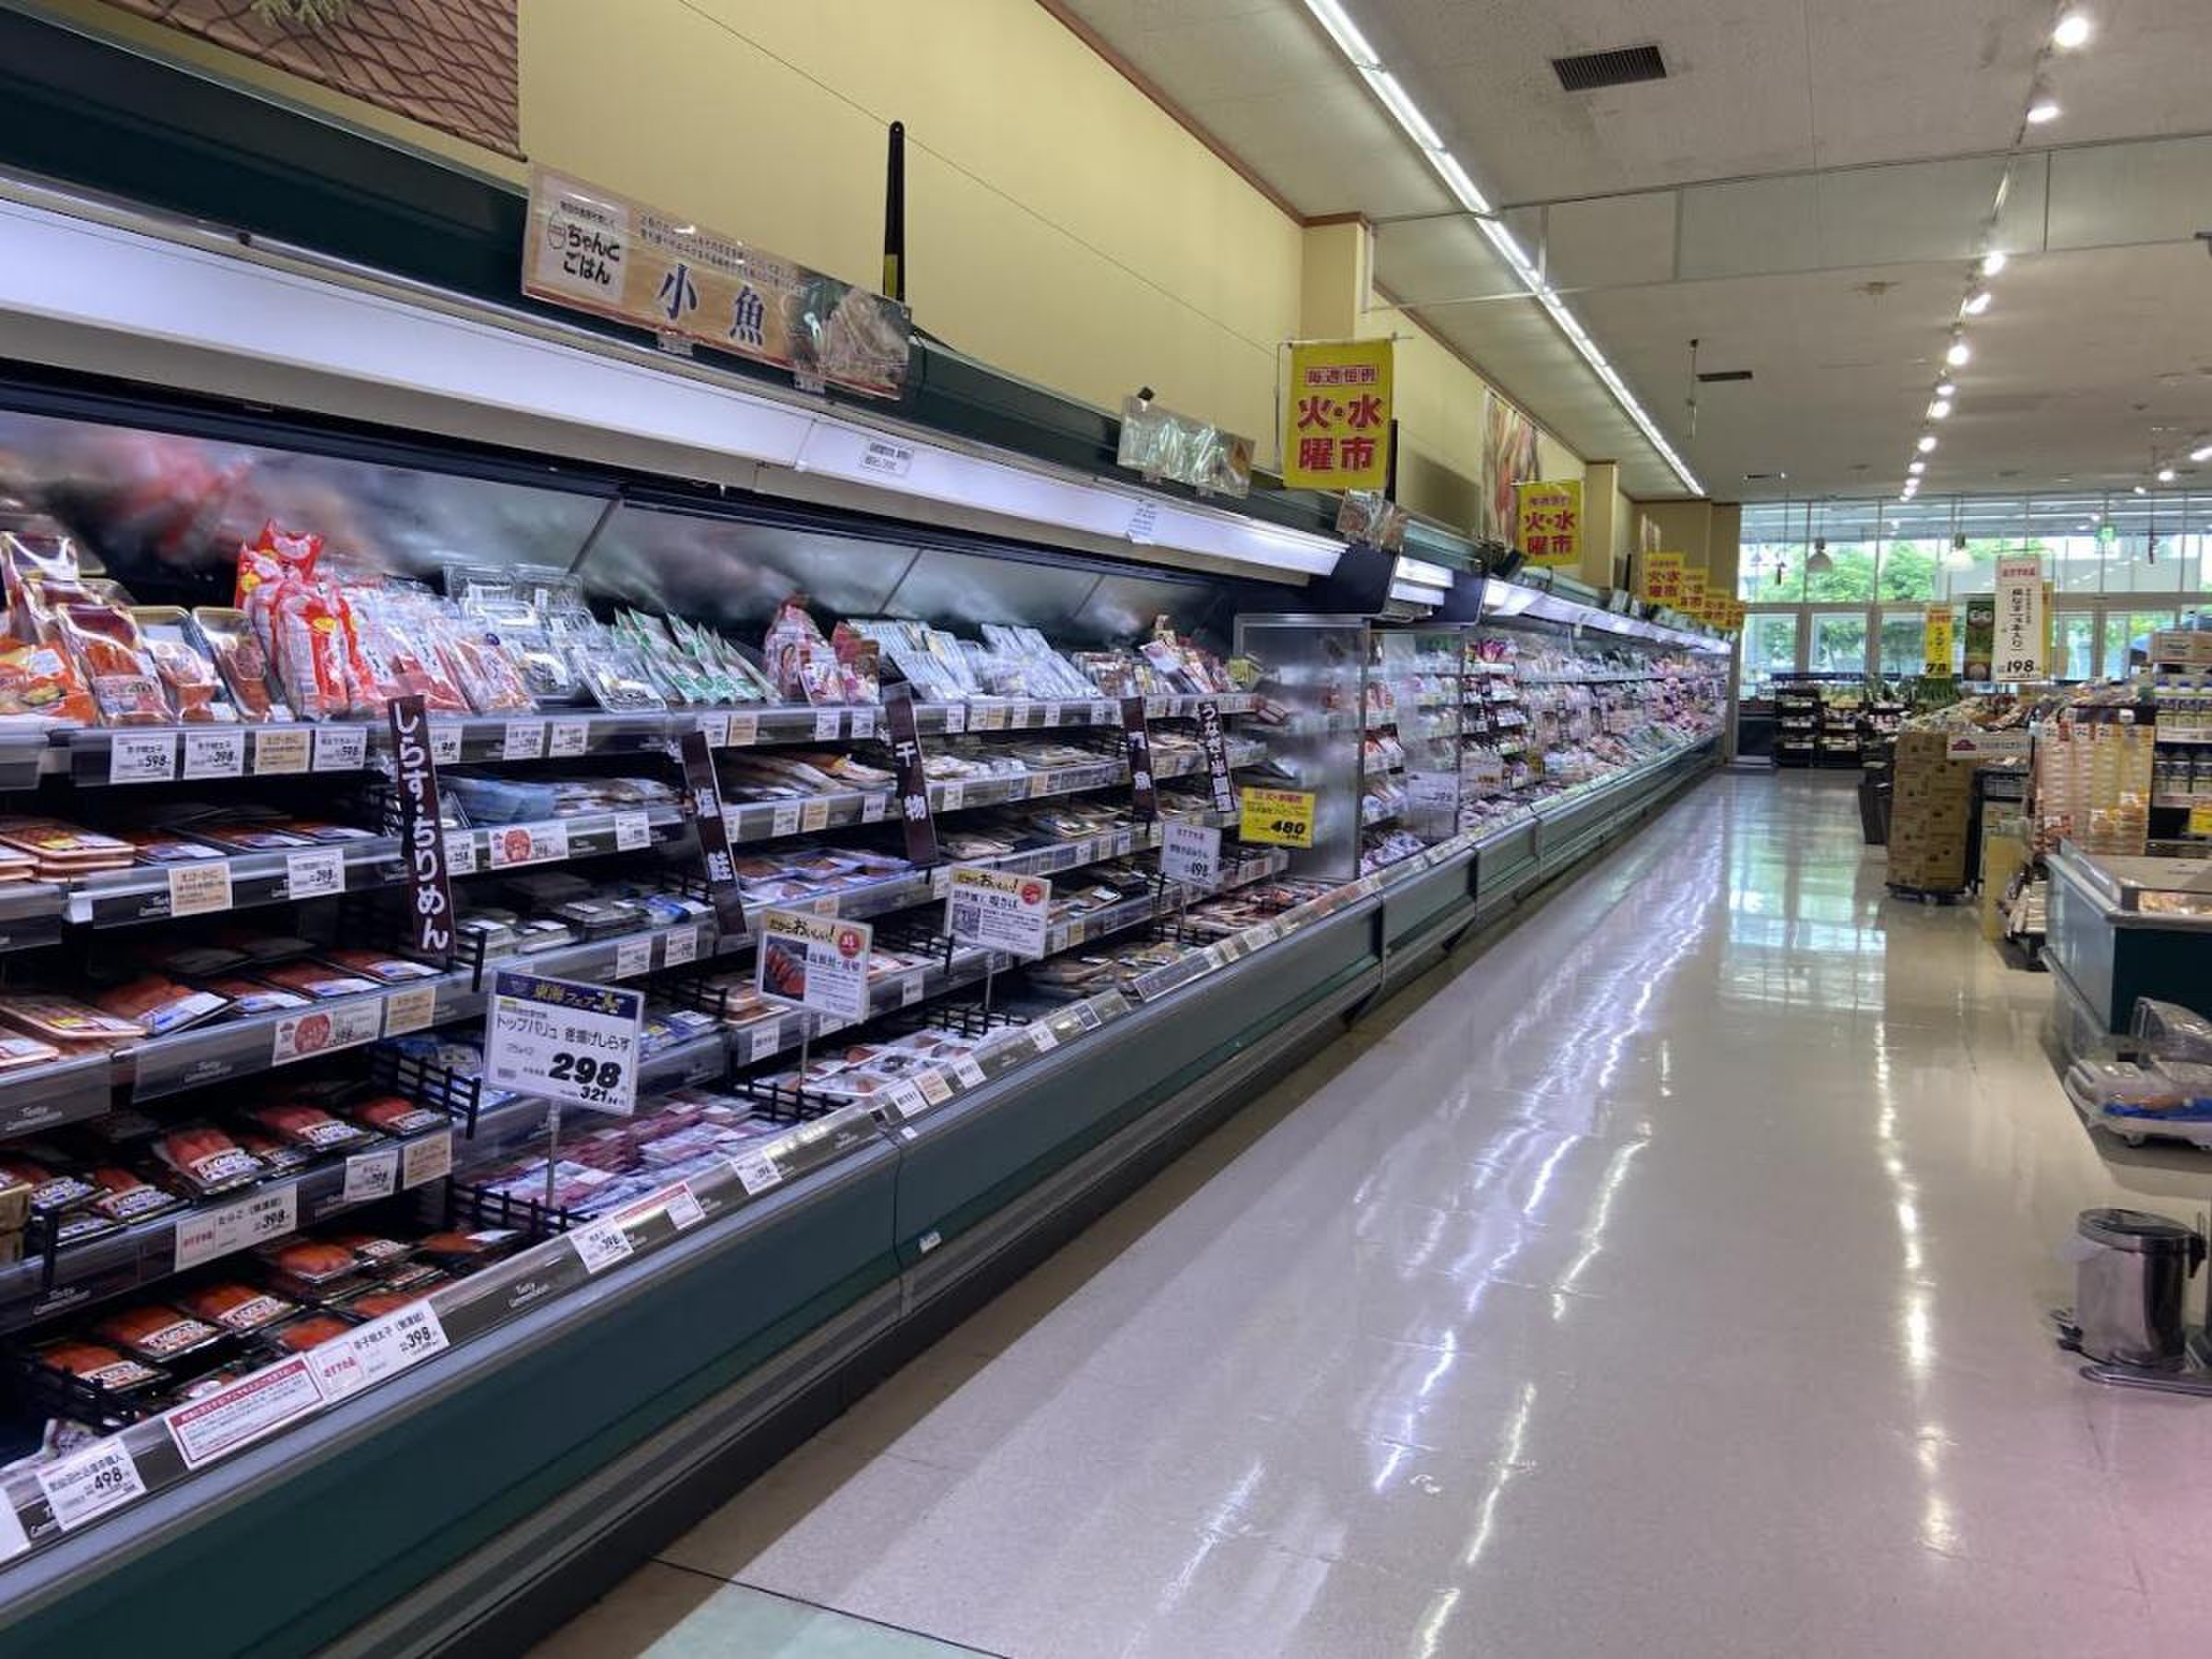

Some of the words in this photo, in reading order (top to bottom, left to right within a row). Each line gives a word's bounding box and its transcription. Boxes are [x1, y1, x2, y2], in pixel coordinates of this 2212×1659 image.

[568, 224, 620, 263] ちゃんと
[563, 252, 611, 285] ごはん
[656, 264, 765, 347] 小魚
[1298, 394, 1382, 429] 火・水
[1299, 437, 1376, 471] 曜市
[1525, 510, 1575, 531] 火・水
[1527, 535, 1573, 555] 曜市
[2006, 659, 2034, 674] 198
[145, 754, 167, 767] 598
[394, 702, 449, 949] しらす・ちりめん
[548, 1053, 621, 1088] 298
[407, 1327, 431, 1348] 398
[95, 1466, 122, 1489] 498
